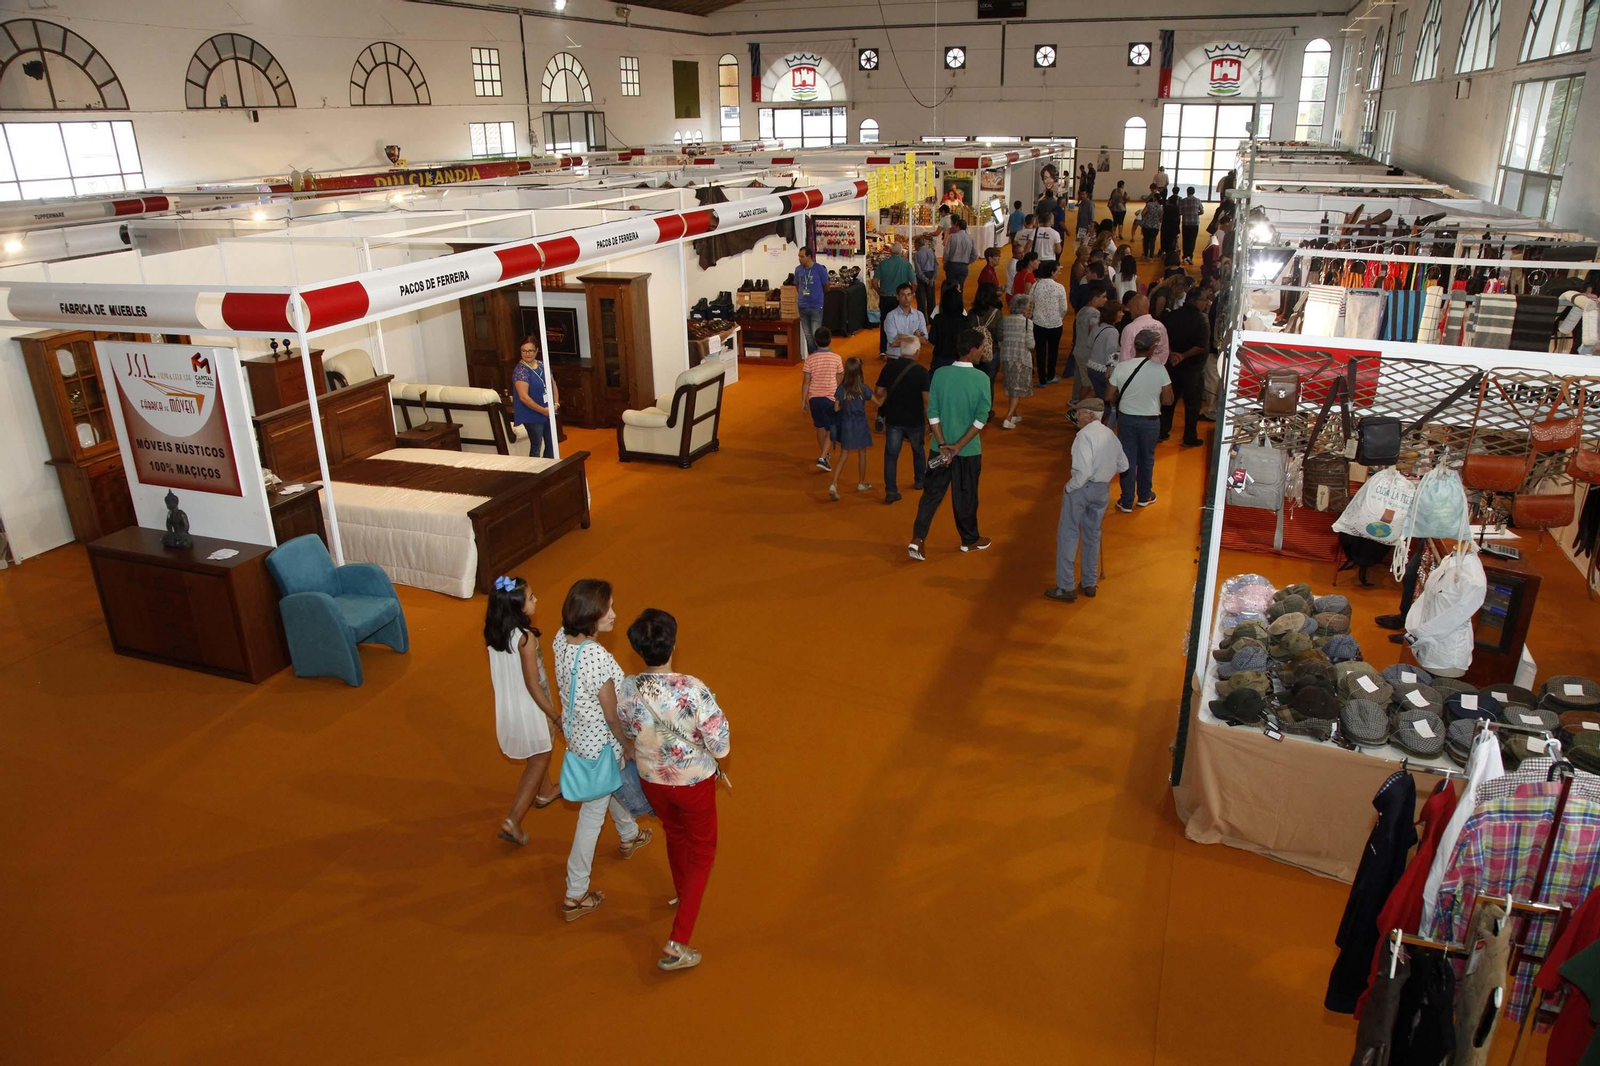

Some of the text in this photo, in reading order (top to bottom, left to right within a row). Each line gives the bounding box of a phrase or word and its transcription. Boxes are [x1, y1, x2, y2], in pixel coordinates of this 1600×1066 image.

[33, 212, 65, 220] TUPPERWARE
[596, 231, 639, 249] PACOS DE FERREIRA
[399, 269, 470, 297] PACOS DE FERREIRA
[59, 302, 148, 317] FABRICA DE MUEBLES
[194, 374, 213, 382] CAPITAL
[168, 397, 195, 414] MÓVEIS
[136, 437, 225, 459] MÓVEIS RÚSTICOS
[149, 460, 221, 480] 100% MAÇIÇOS
